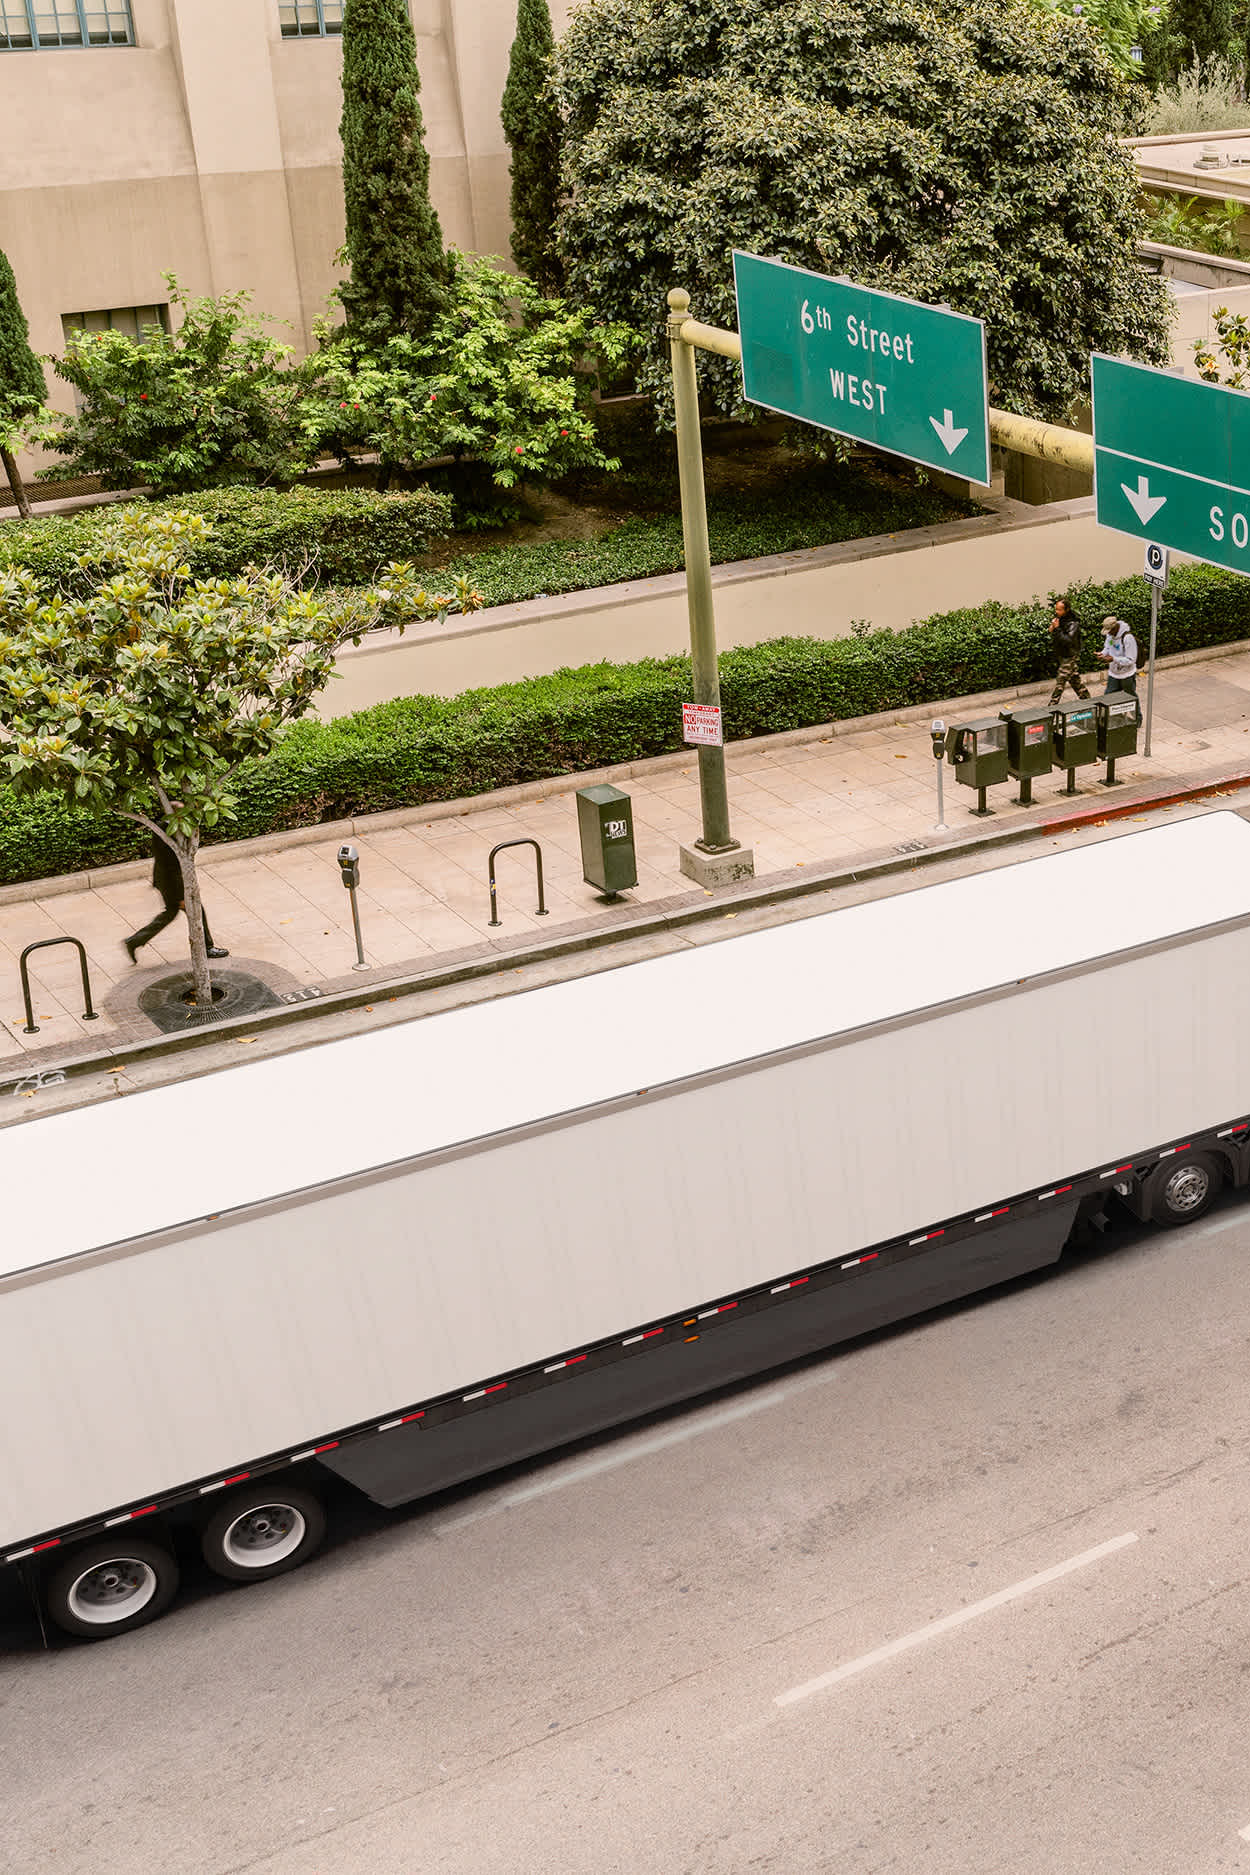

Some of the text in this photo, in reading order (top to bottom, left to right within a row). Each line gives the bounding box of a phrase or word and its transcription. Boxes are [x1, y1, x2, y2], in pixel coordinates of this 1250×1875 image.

[801, 299, 914, 364] 6th Street
[829, 368, 887, 415] WEST
[685, 714, 719, 726] NO PARKING
[687, 725, 718, 736] ANY TIME
